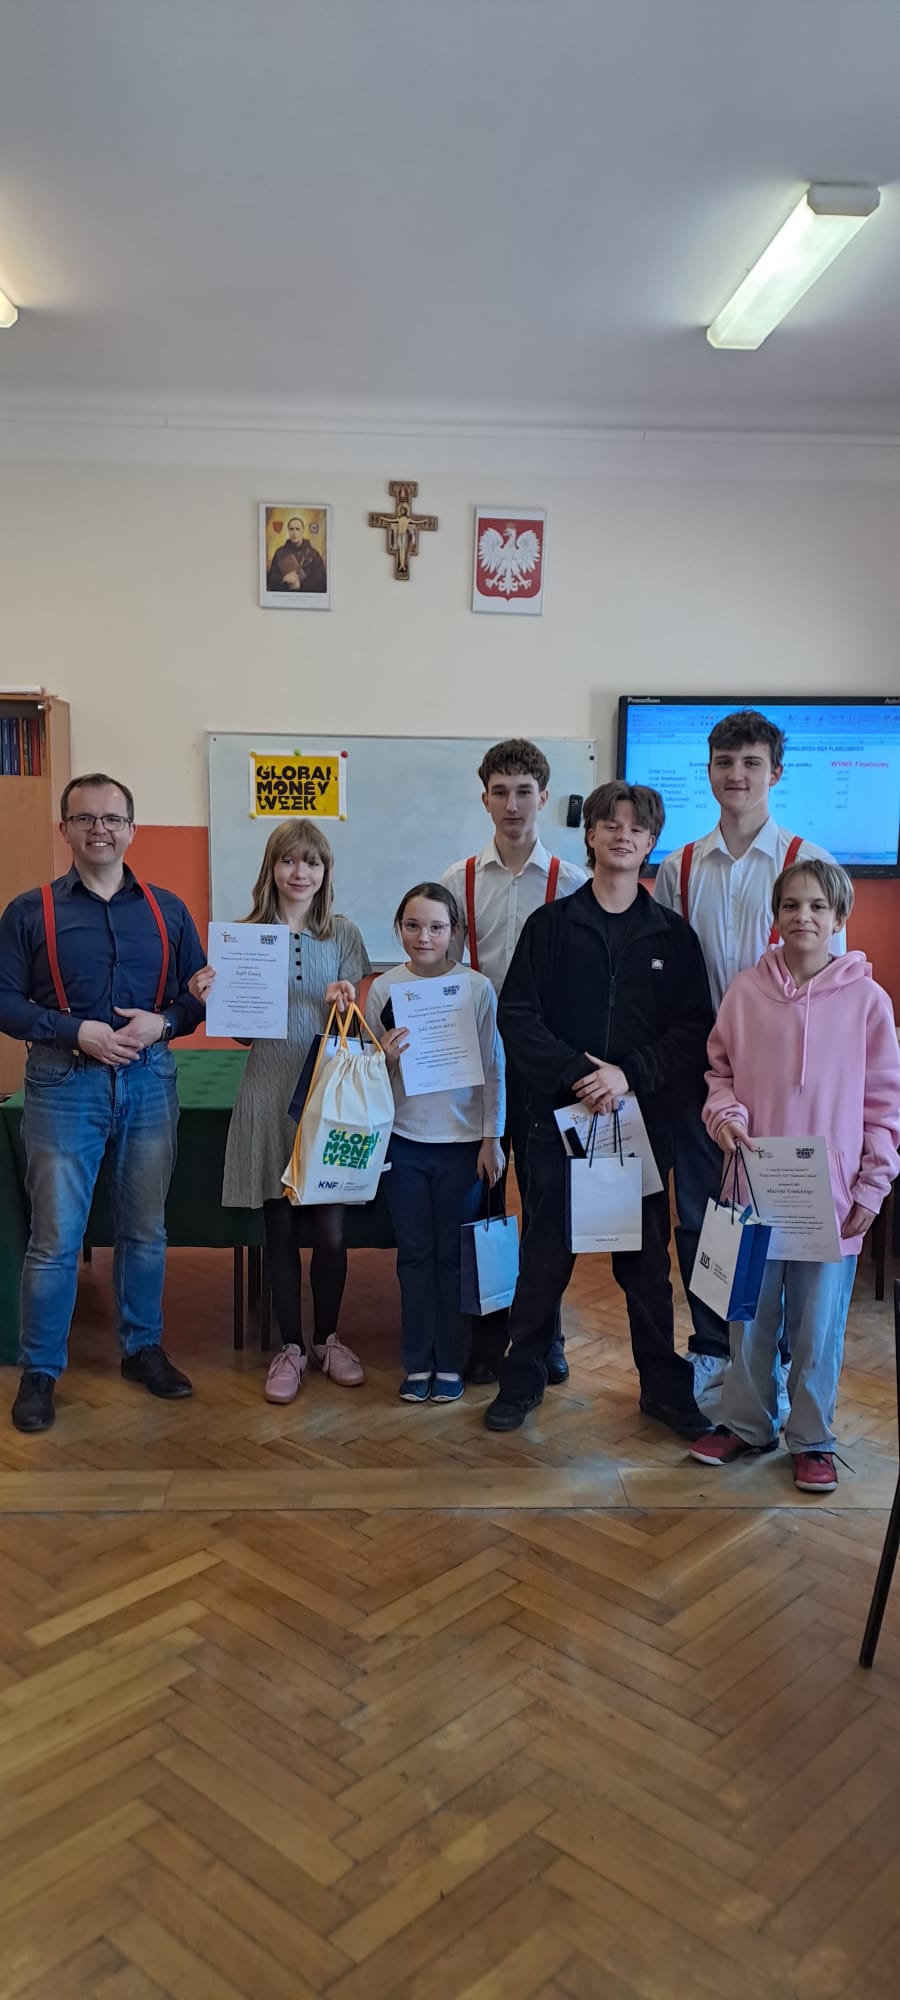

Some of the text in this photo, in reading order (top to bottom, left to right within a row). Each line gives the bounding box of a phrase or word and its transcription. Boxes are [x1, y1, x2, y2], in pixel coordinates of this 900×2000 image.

[256, 766, 335, 780] GLOBAL
[257, 781, 329, 795] MONEY
[257, 796, 317, 810] WEEK
[318, 1180, 339, 1190] KNF
